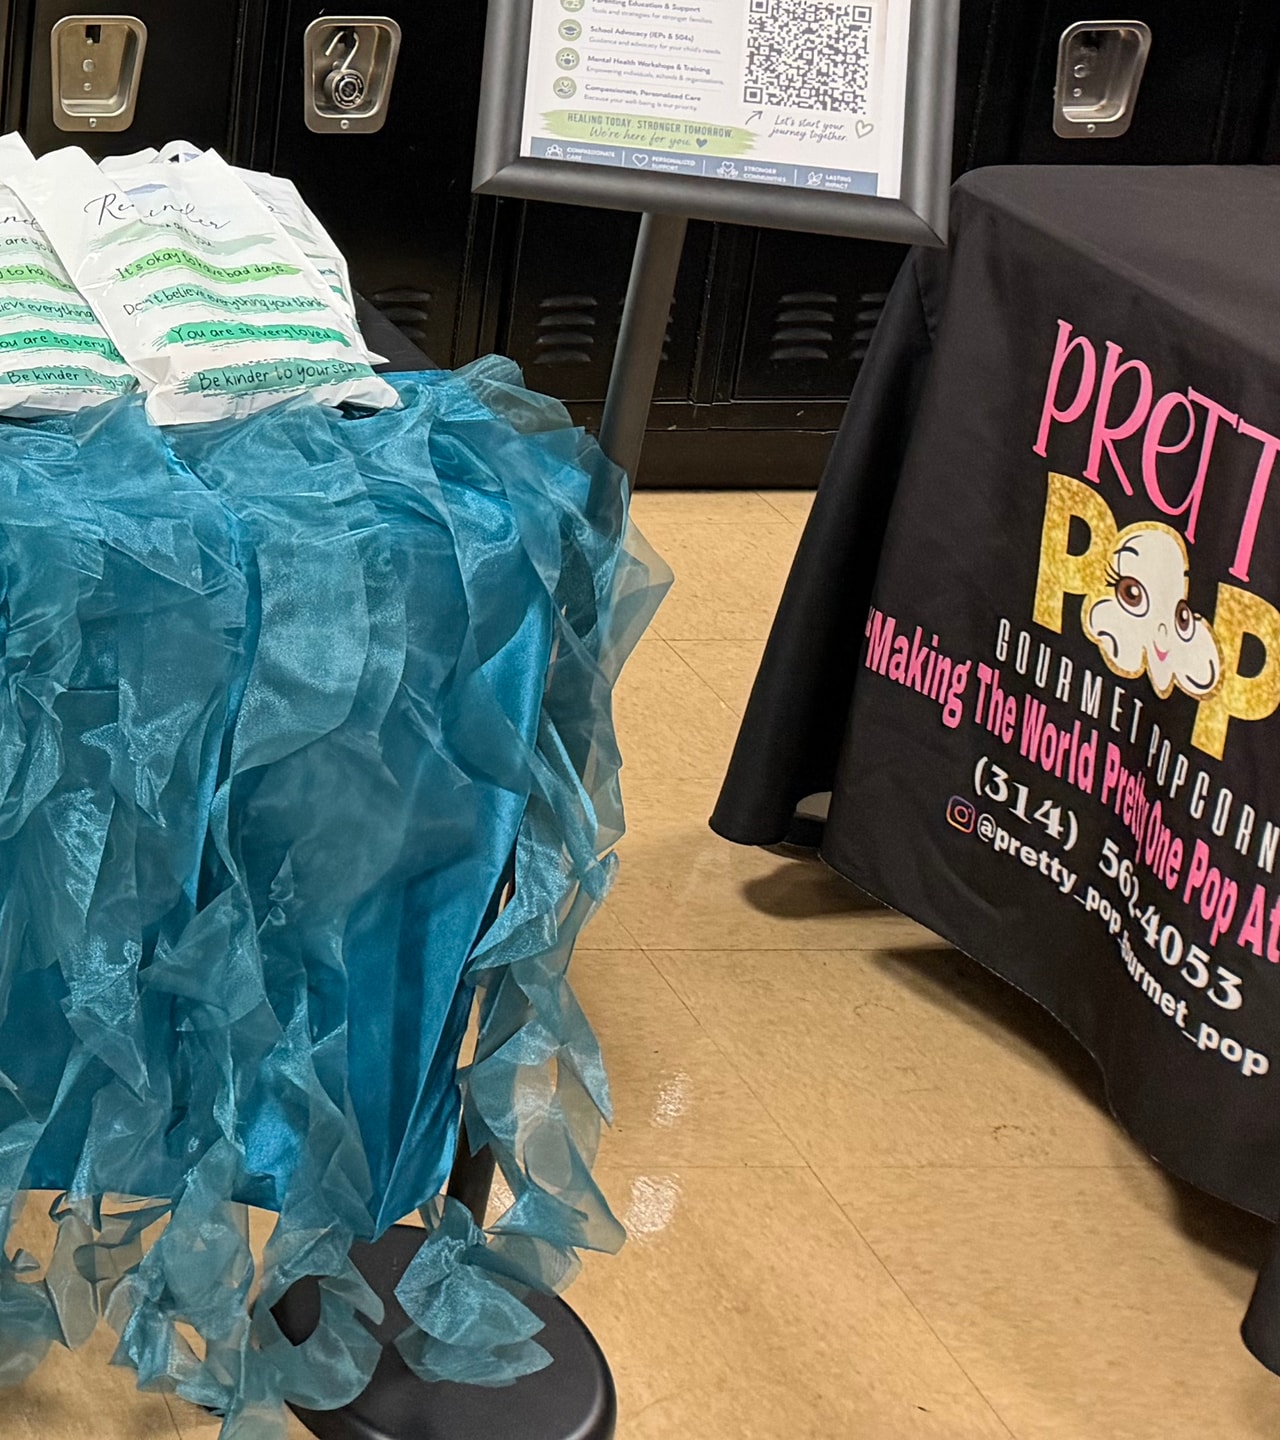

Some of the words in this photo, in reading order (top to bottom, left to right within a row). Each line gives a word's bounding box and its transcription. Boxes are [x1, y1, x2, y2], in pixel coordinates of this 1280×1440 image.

[628, 0, 663, 9] Education
[672, 4, 701, 13] Support
[590, 26, 613, 34] School
[615, 28, 648, 38] Advocacy
[640, 89, 683, 101] Personalized
[685, 94, 701, 102] Care
[568, 112, 602, 125] HEALING
[637, 120, 681, 133] STRONGER
[774, 114, 795, 126] Let's
[799, 117, 819, 128] start
[822, 122, 844, 132] your
[590, 126, 620, 139] We're
[624, 131, 647, 142] here
[649, 133, 666, 146] for
[768, 127, 806, 141] journey
[809, 130, 848, 143] together.
[198, 371, 221, 390] Be
[223, 368, 271, 385] kinder
[276, 366, 293, 381] to
[995, 617, 1144, 744] GOURMET
[1146, 723, 1280, 874] POPCORN
[974, 756, 1079, 851] (314)
[975, 662, 1016, 744] The
[1019, 694, 1098, 794] World
[1145, 800, 1184, 890] One
[1183, 838, 1238, 947] Pop
